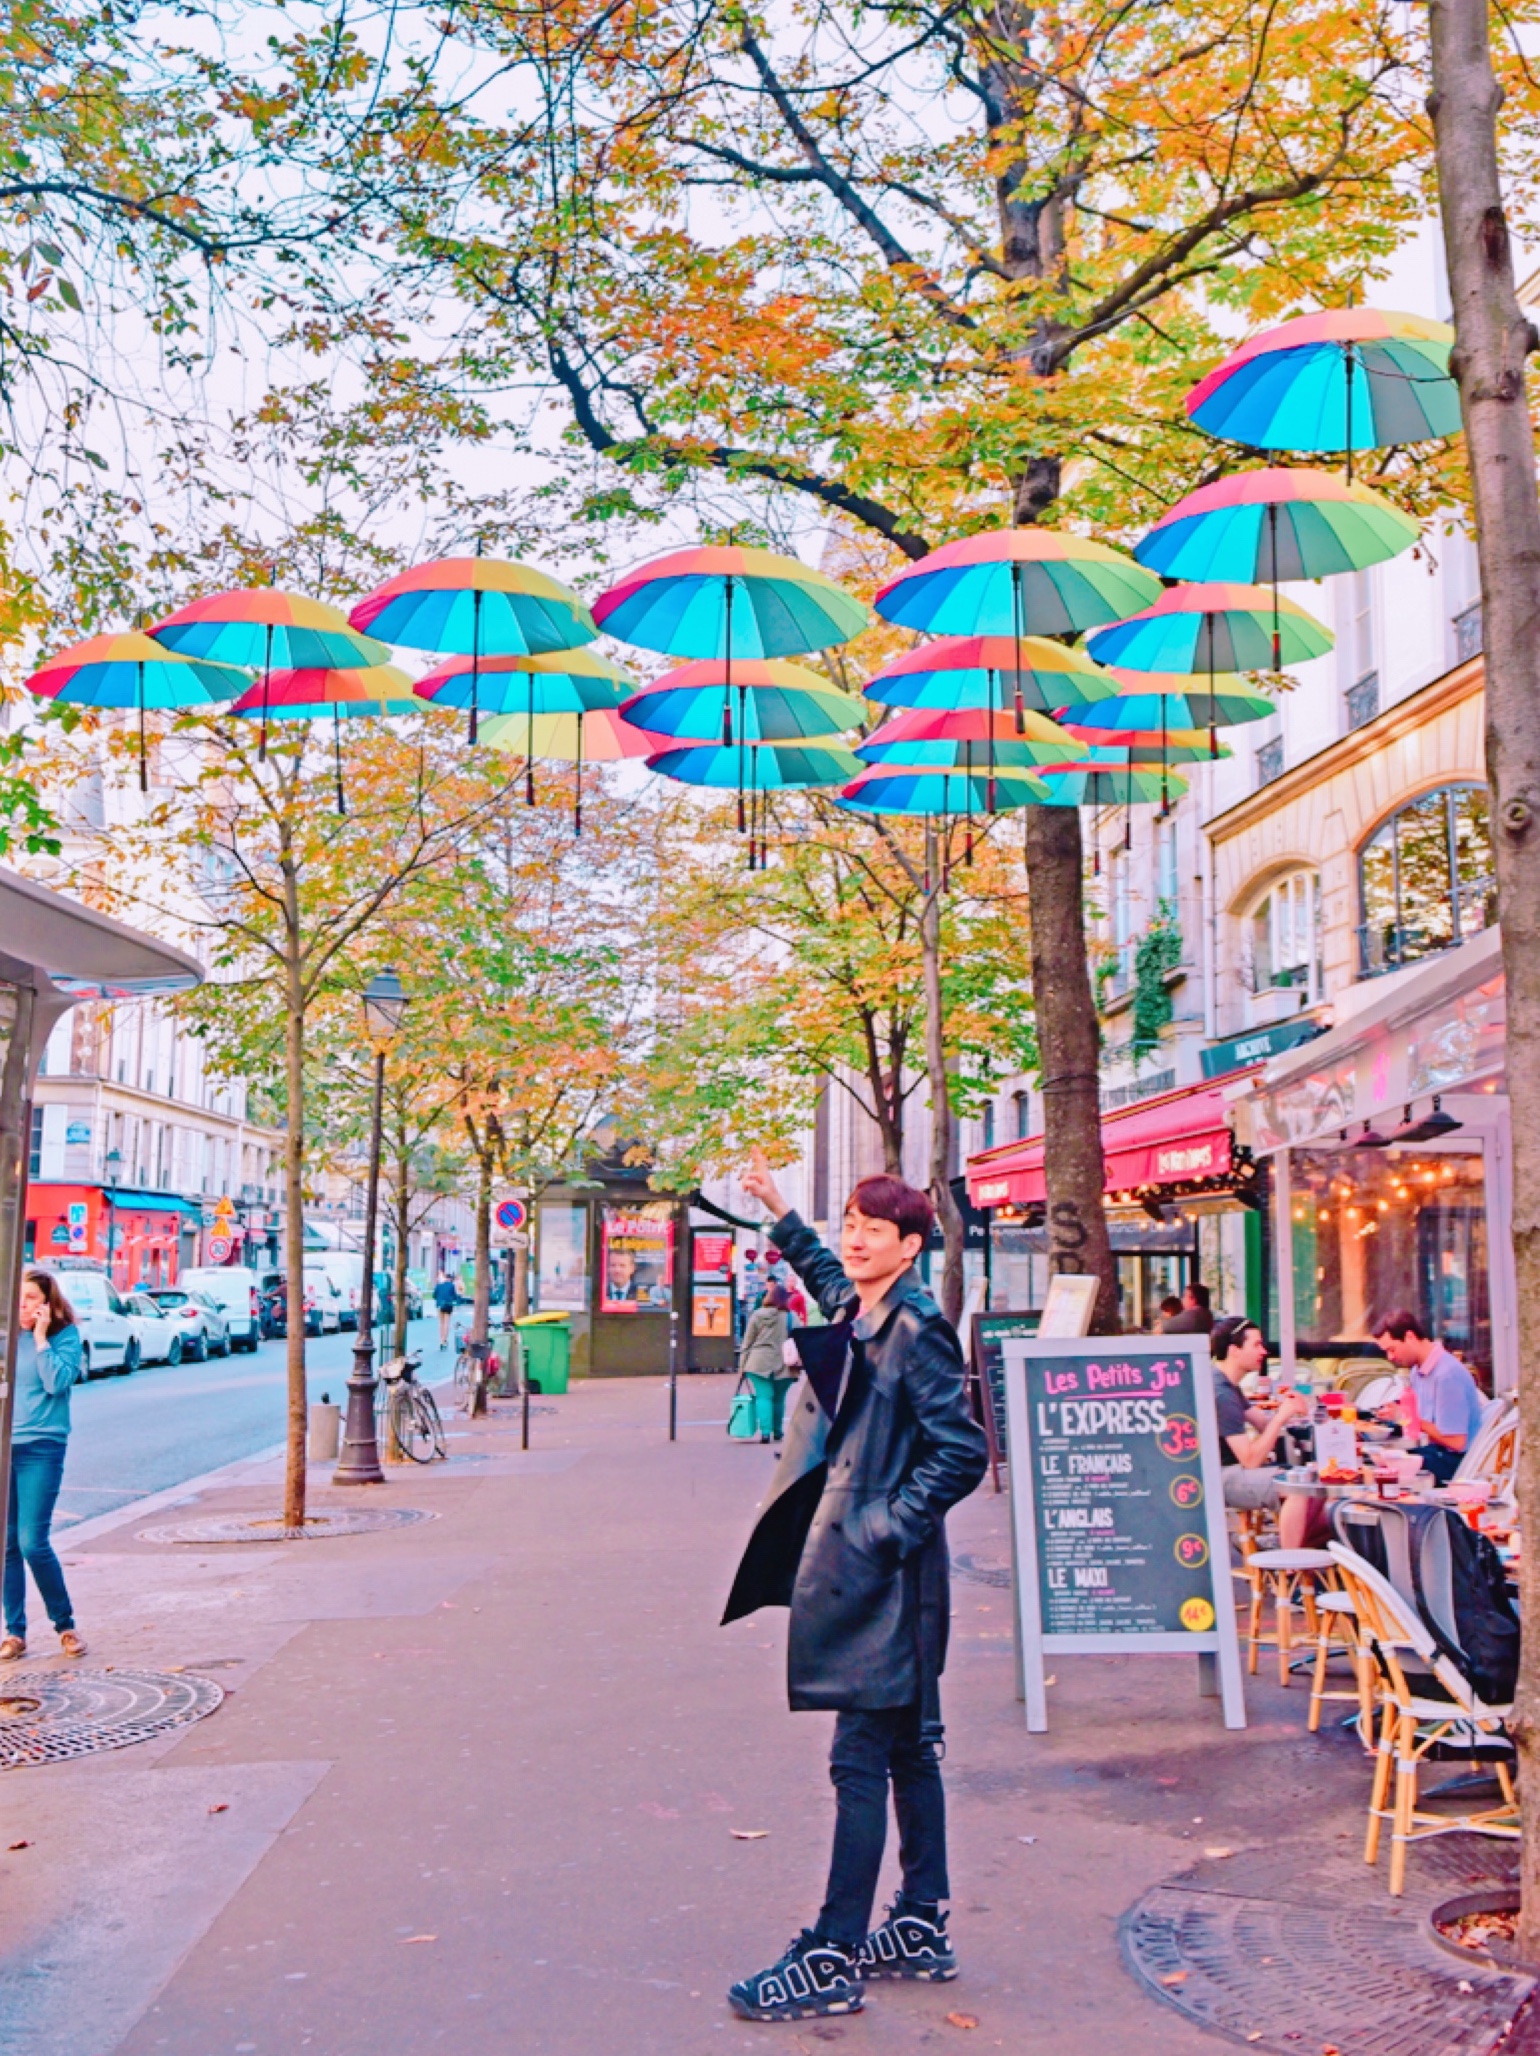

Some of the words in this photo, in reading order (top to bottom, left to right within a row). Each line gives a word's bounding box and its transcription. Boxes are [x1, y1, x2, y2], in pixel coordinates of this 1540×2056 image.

[1044, 1370, 1079, 1394] Les
[1087, 1362, 1143, 1390] Petits
[1037, 1400, 1167, 1436] L'EXPRESS
[1040, 1455, 1061, 1475] LE
[1176, 1481, 1197, 1503] 6€
[1182, 1539, 1202, 1559] 9€
[1047, 1568, 1068, 1588] LE
[759, 1948, 855, 2007] AIR
